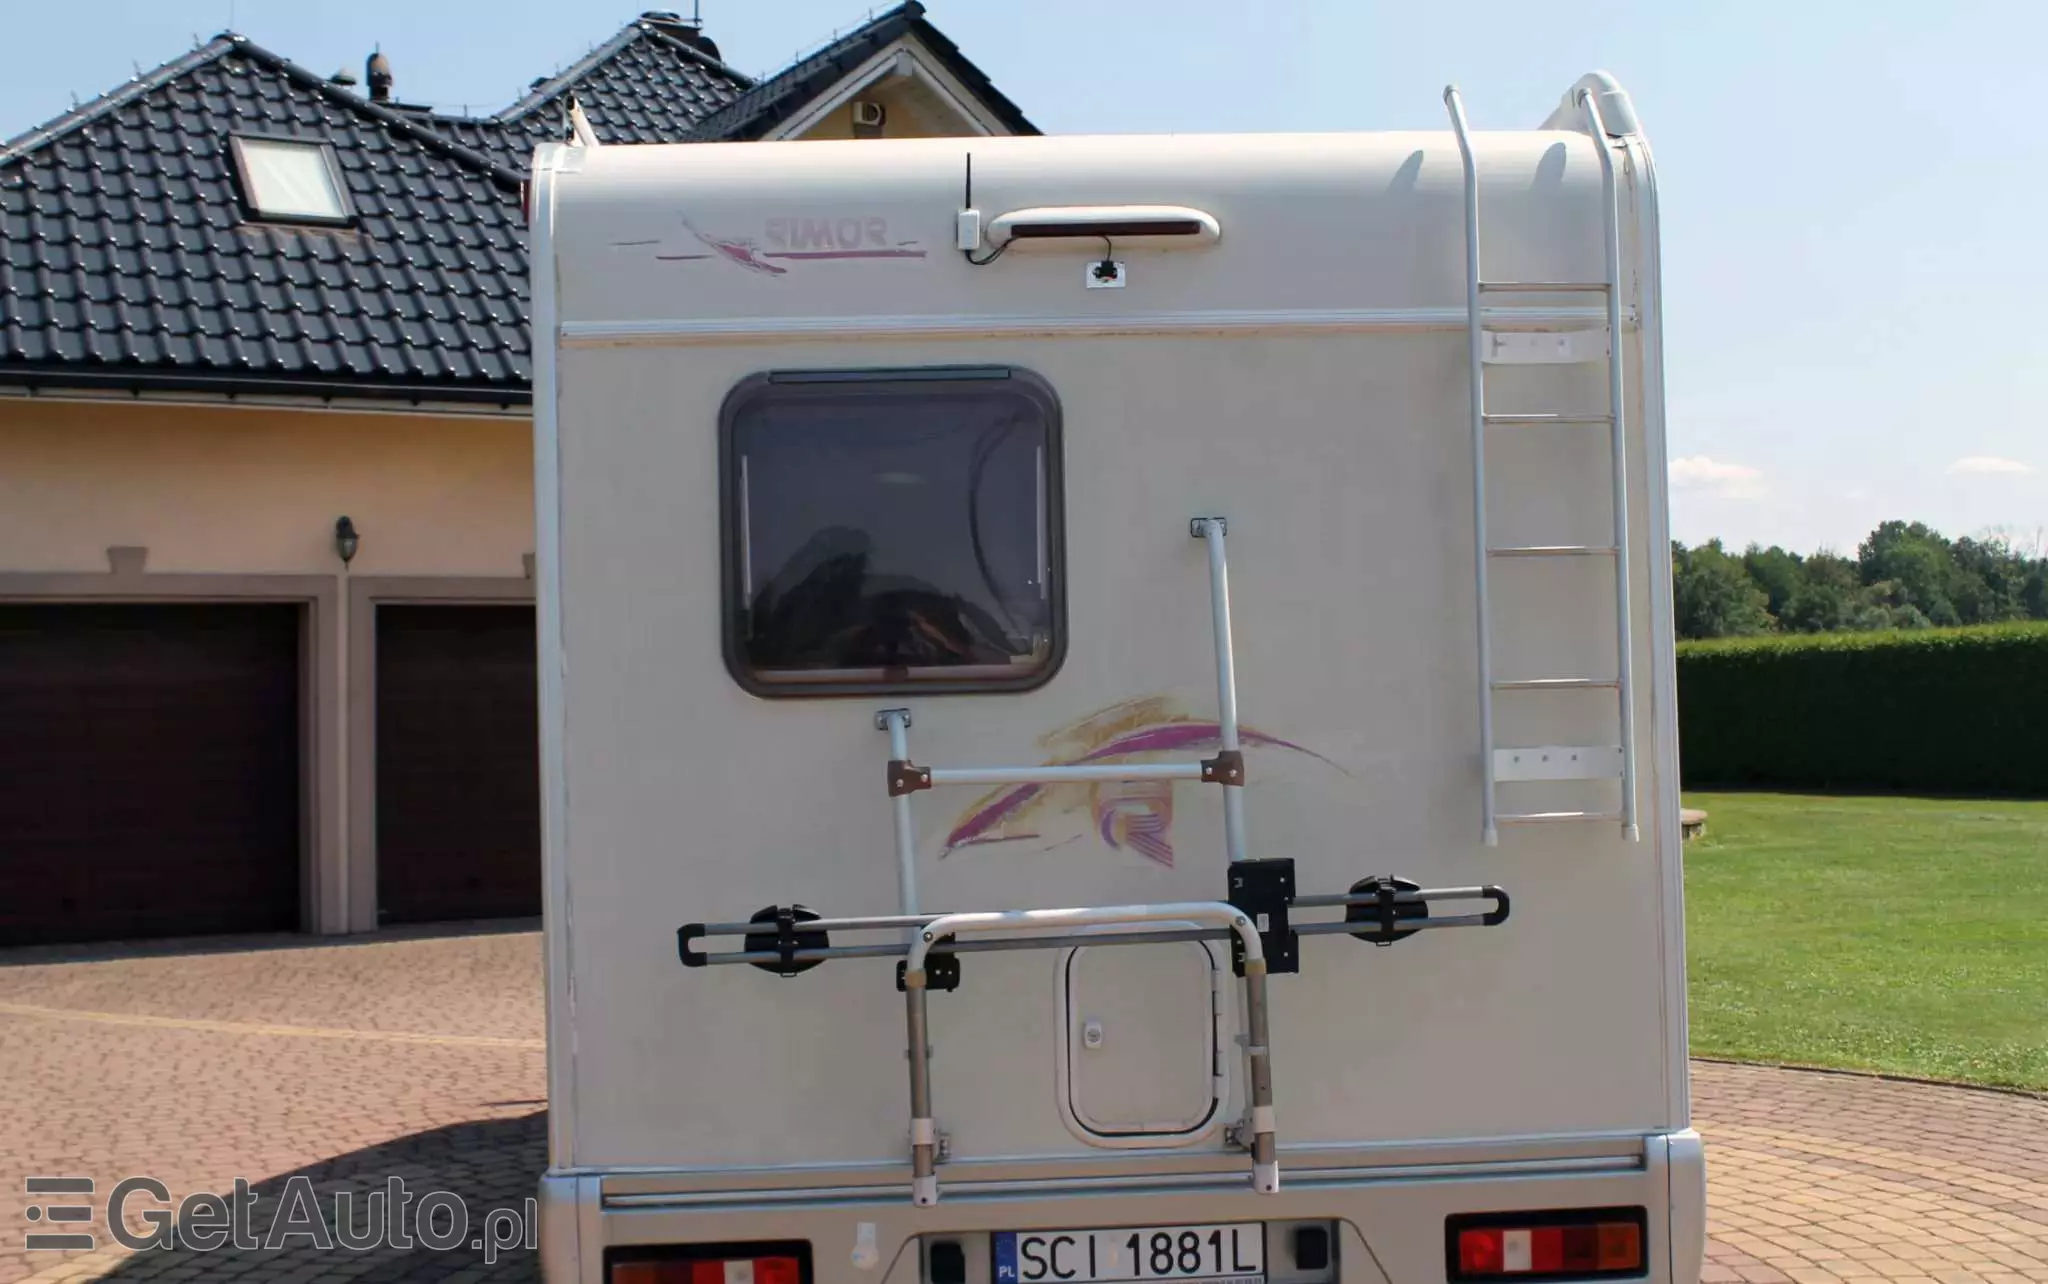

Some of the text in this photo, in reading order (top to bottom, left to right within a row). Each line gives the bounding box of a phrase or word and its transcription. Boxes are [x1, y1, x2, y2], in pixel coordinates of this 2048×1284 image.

[765, 216, 887, 249] RIMOR
[1020, 1229, 1257, 1280] SCI 1881L
[999, 1265, 1015, 1278] PL
